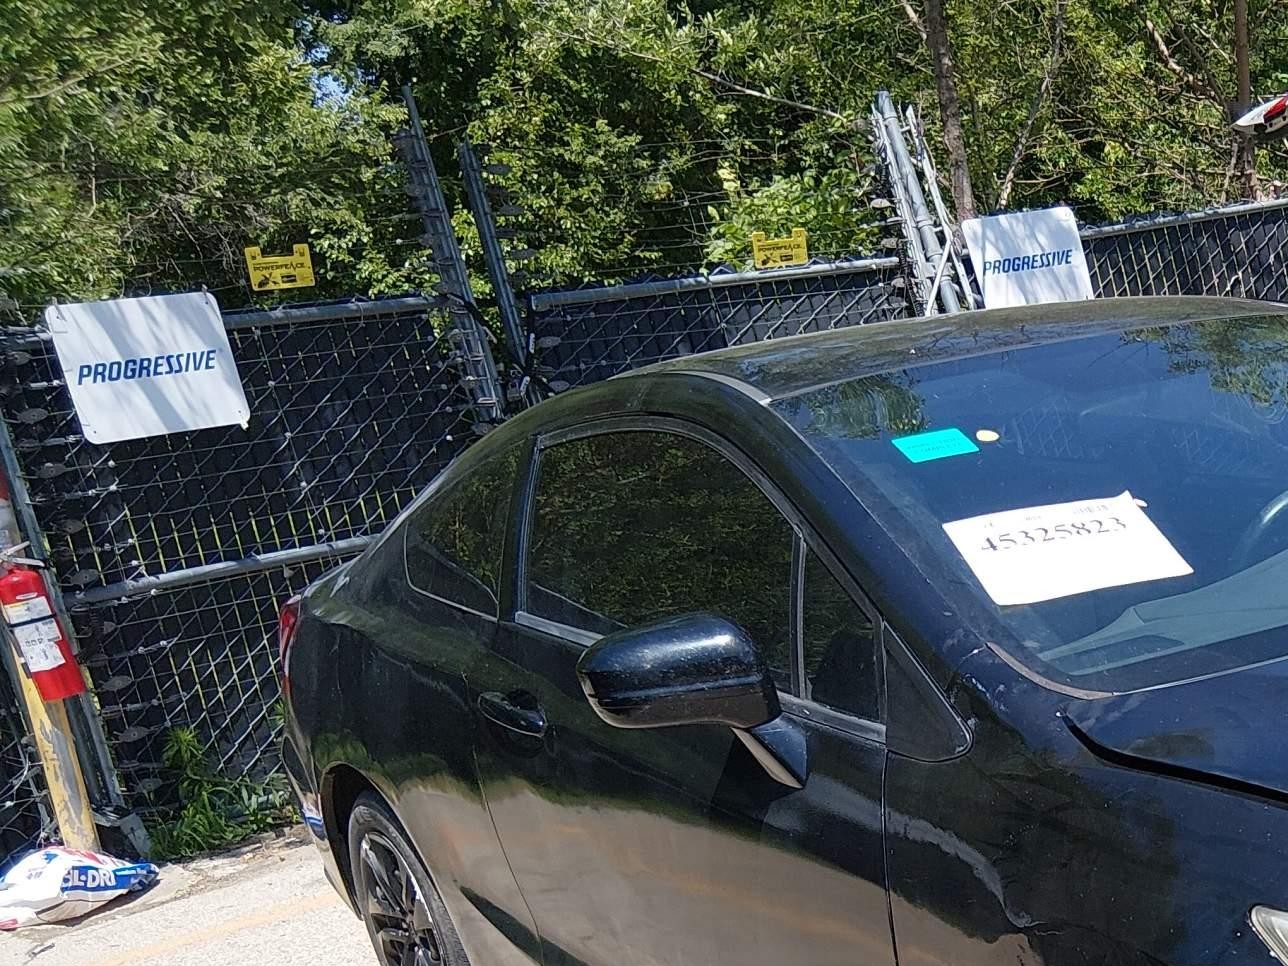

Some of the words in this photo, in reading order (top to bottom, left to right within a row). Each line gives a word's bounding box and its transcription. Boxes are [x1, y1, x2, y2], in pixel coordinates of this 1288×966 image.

[982, 249, 1073, 276] PROGRESSIVE
[77, 350, 216, 385] PROGRESSIVE
[981, 517, 1127, 551] 45325823
